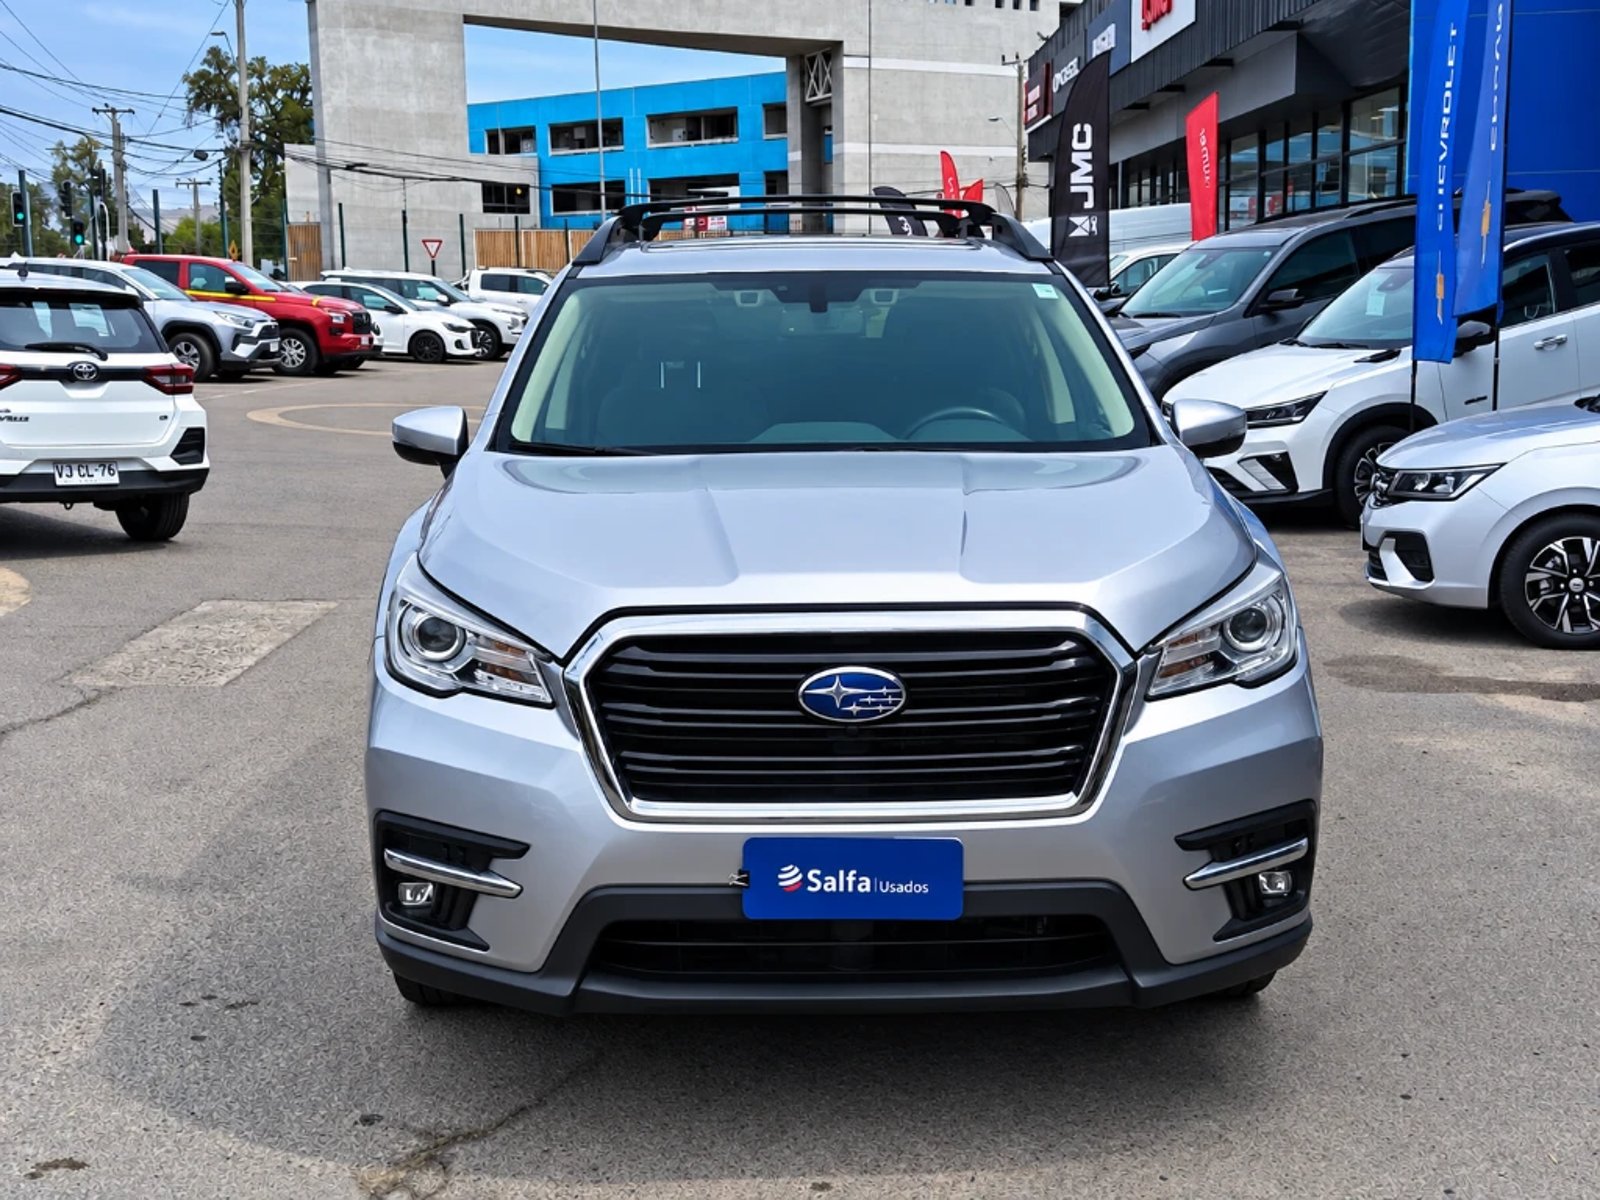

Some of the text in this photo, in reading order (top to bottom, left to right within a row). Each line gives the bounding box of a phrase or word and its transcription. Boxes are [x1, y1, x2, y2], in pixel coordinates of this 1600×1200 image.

[1070, 123, 1095, 209] JMC
[806, 868, 929, 893] Salfa Usados
